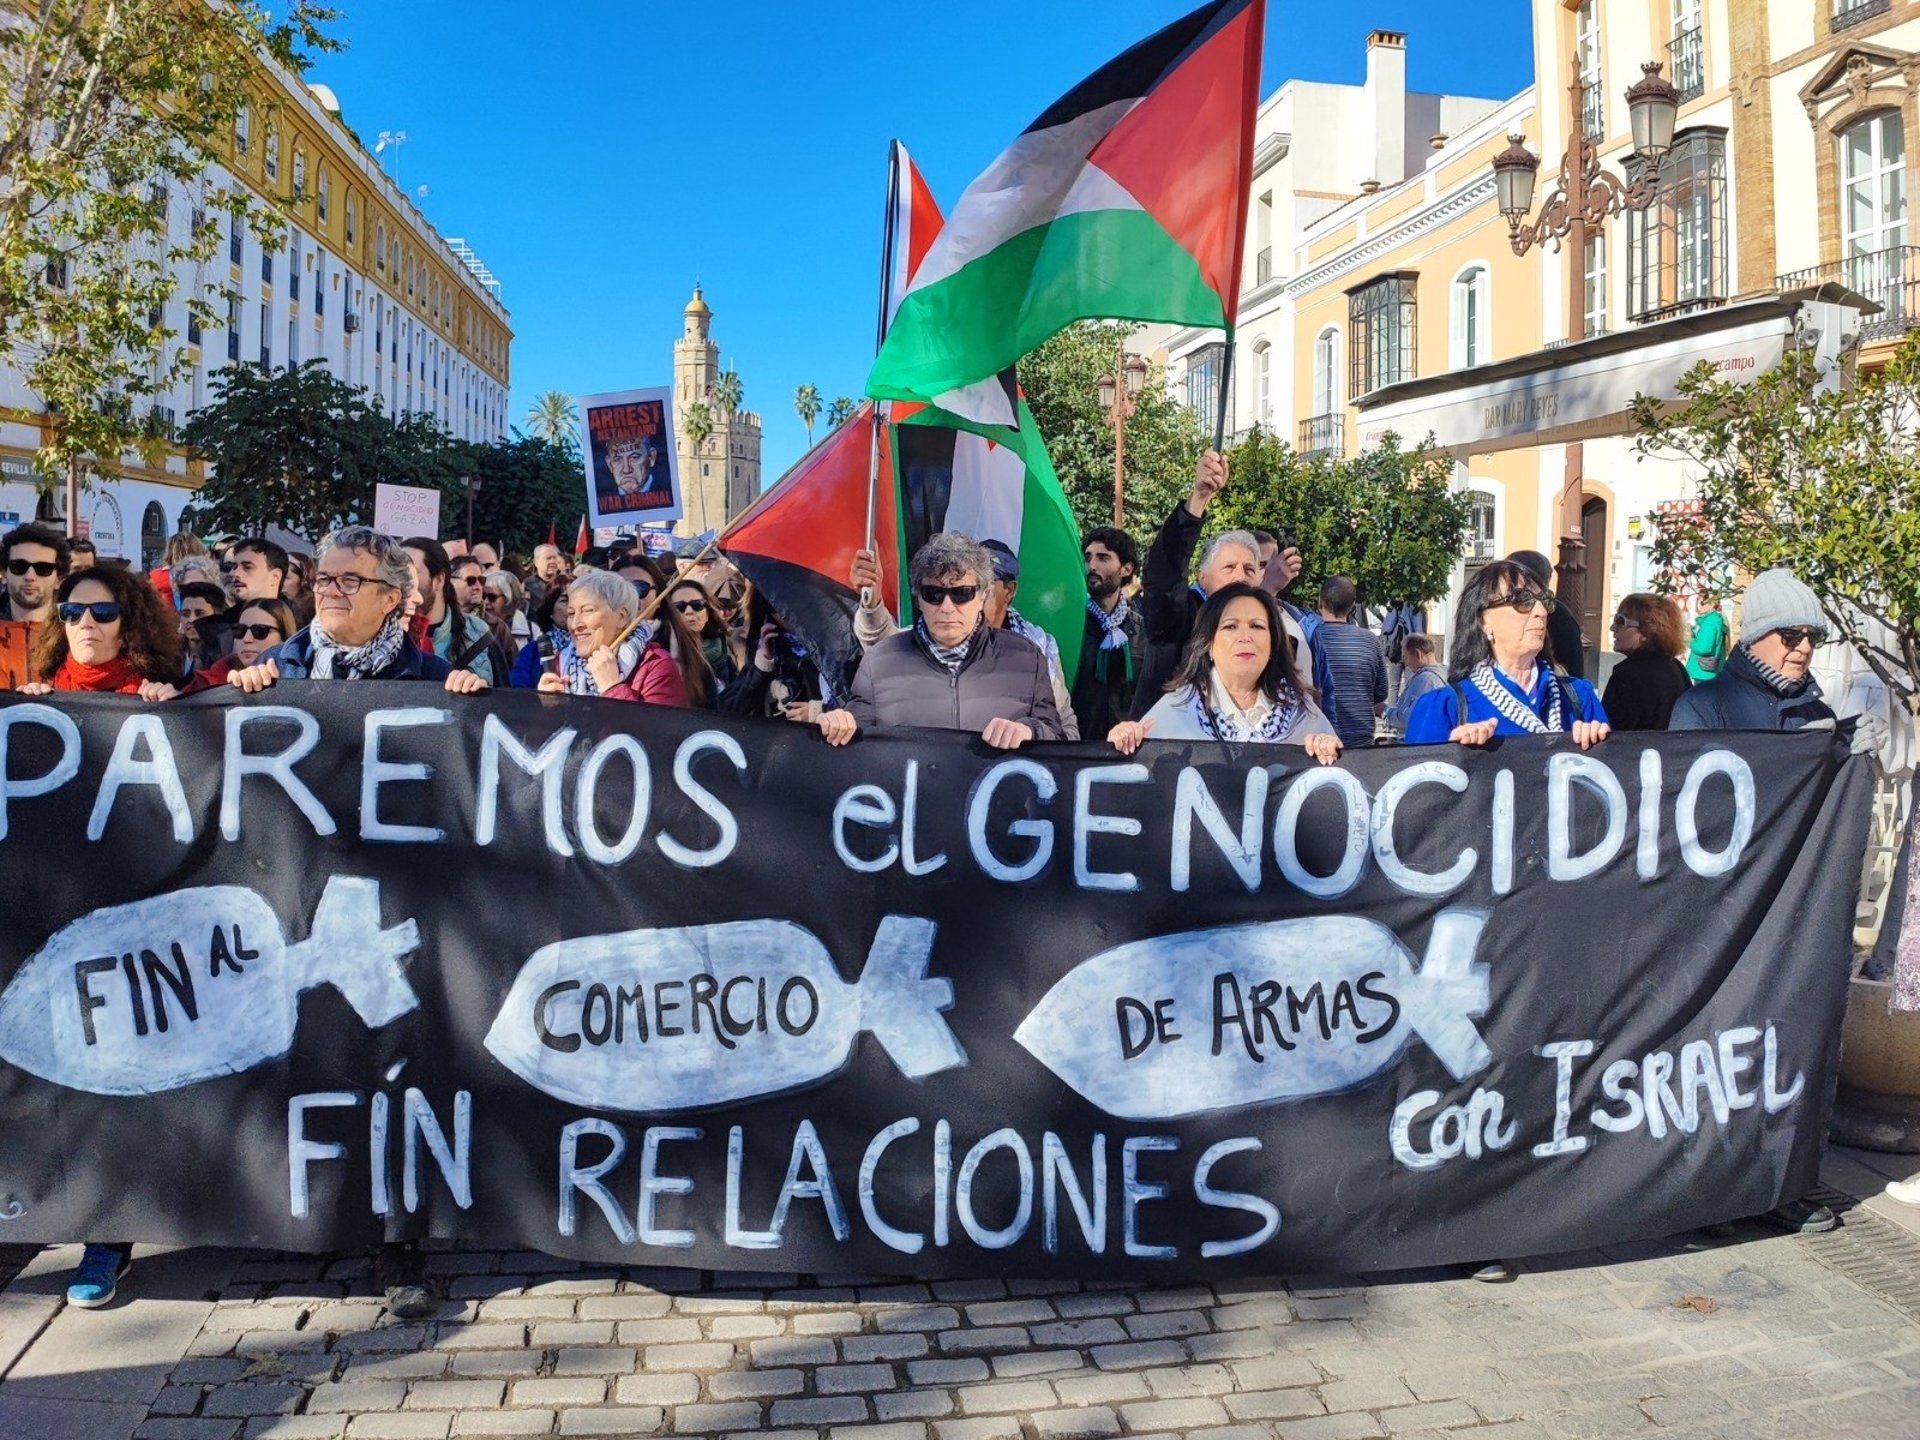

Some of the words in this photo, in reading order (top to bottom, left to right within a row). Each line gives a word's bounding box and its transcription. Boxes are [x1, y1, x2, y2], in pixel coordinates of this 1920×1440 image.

[590, 403, 660, 430] ARREST
[1484, 405, 1501, 430] BAR
[1503, 399, 1528, 426] MARY
[1530, 393, 1560, 421] REYES
[1, 462, 29, 475] SEVILLA
[393, 490, 427, 503] STOP
[599, 495, 622, 512] WAR
[624, 489, 671, 509] CRIMINAL
[391, 512, 427, 525] GAZA
[0, 703, 748, 868] PAREMOS
[966, 748, 1756, 897] GENOCIDIO
[75, 941, 198, 1045] FIN
[210, 924, 259, 978] AL
[533, 973, 820, 1053] COMERCIO
[1116, 996, 1182, 1061] DE
[1211, 970, 1401, 1064] ARMAS
[558, 1116, 1282, 1260] RELACIONES
[1388, 1084, 1516, 1170] con
[1533, 1020, 1805, 1159] ISRAEL
